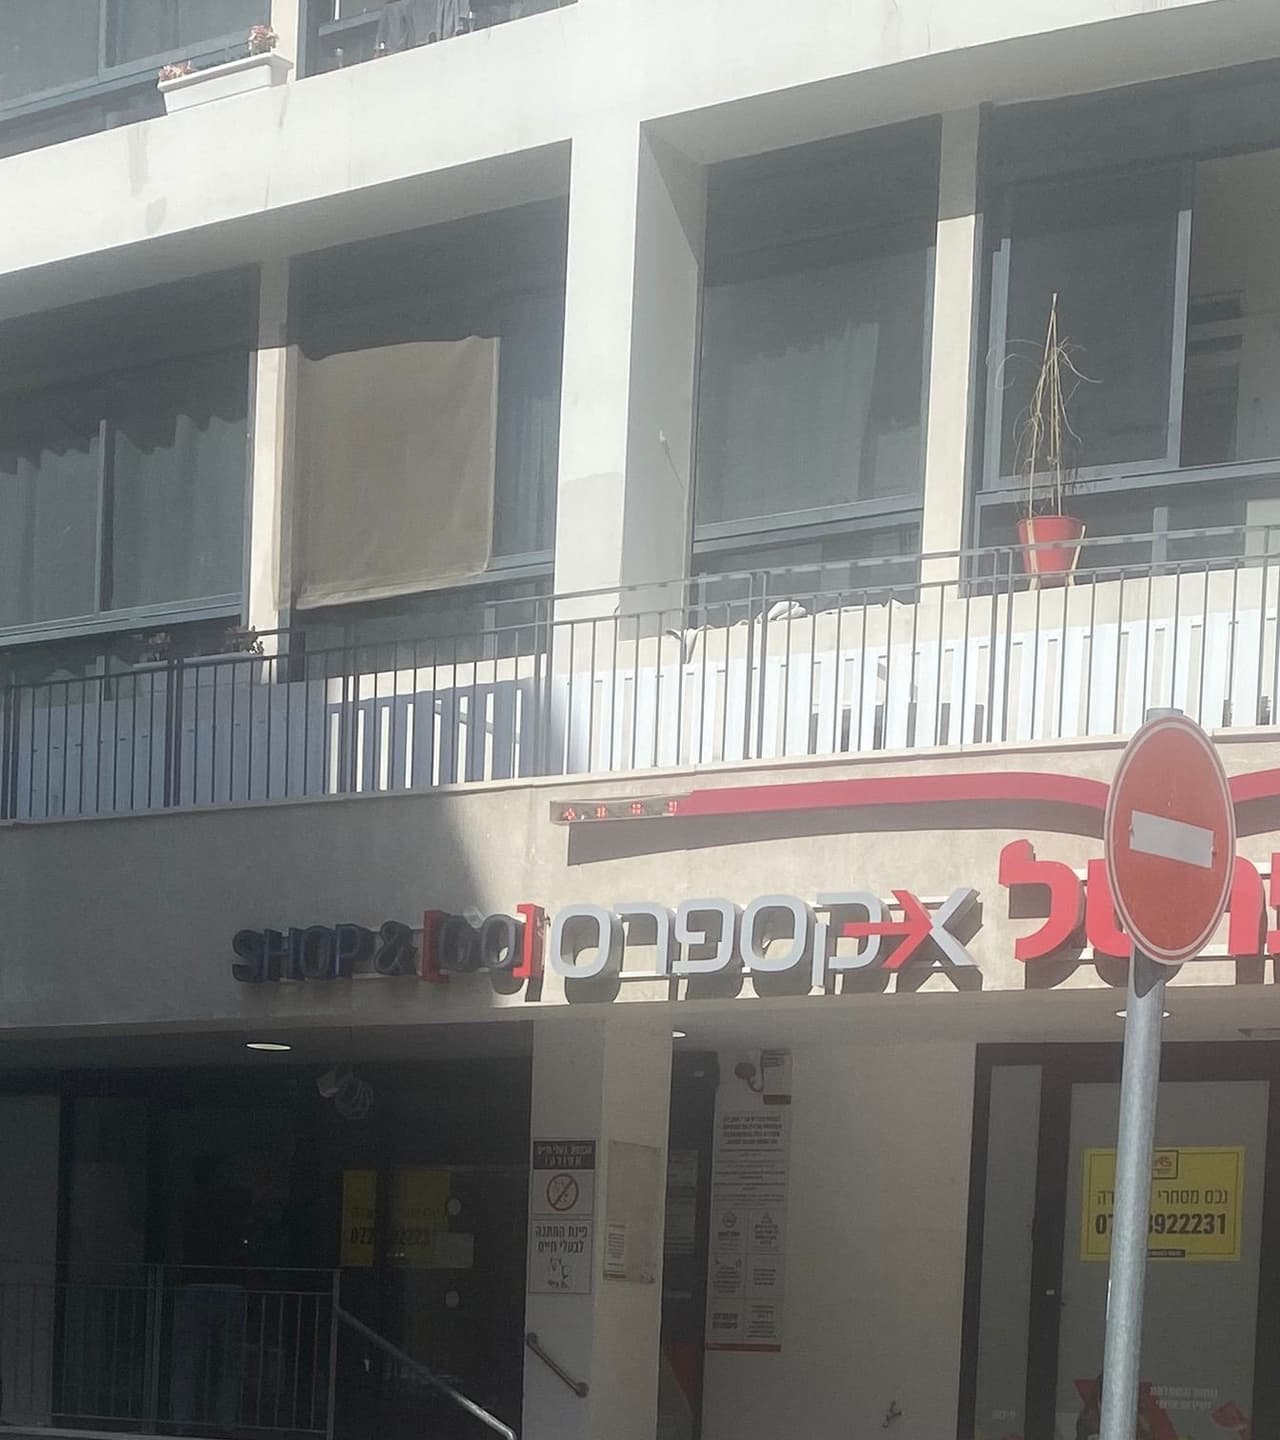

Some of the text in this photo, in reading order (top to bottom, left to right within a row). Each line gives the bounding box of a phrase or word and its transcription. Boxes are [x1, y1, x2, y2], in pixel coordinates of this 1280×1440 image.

[231, 922, 372, 983] SHOP
[374, 919, 418, 976] &
[1158, 1189, 1228, 1205] נכס מסחרי
[535, 1225, 588, 1238] פינת המתנה
[538, 1239, 584, 1254] לבעלי חיים
